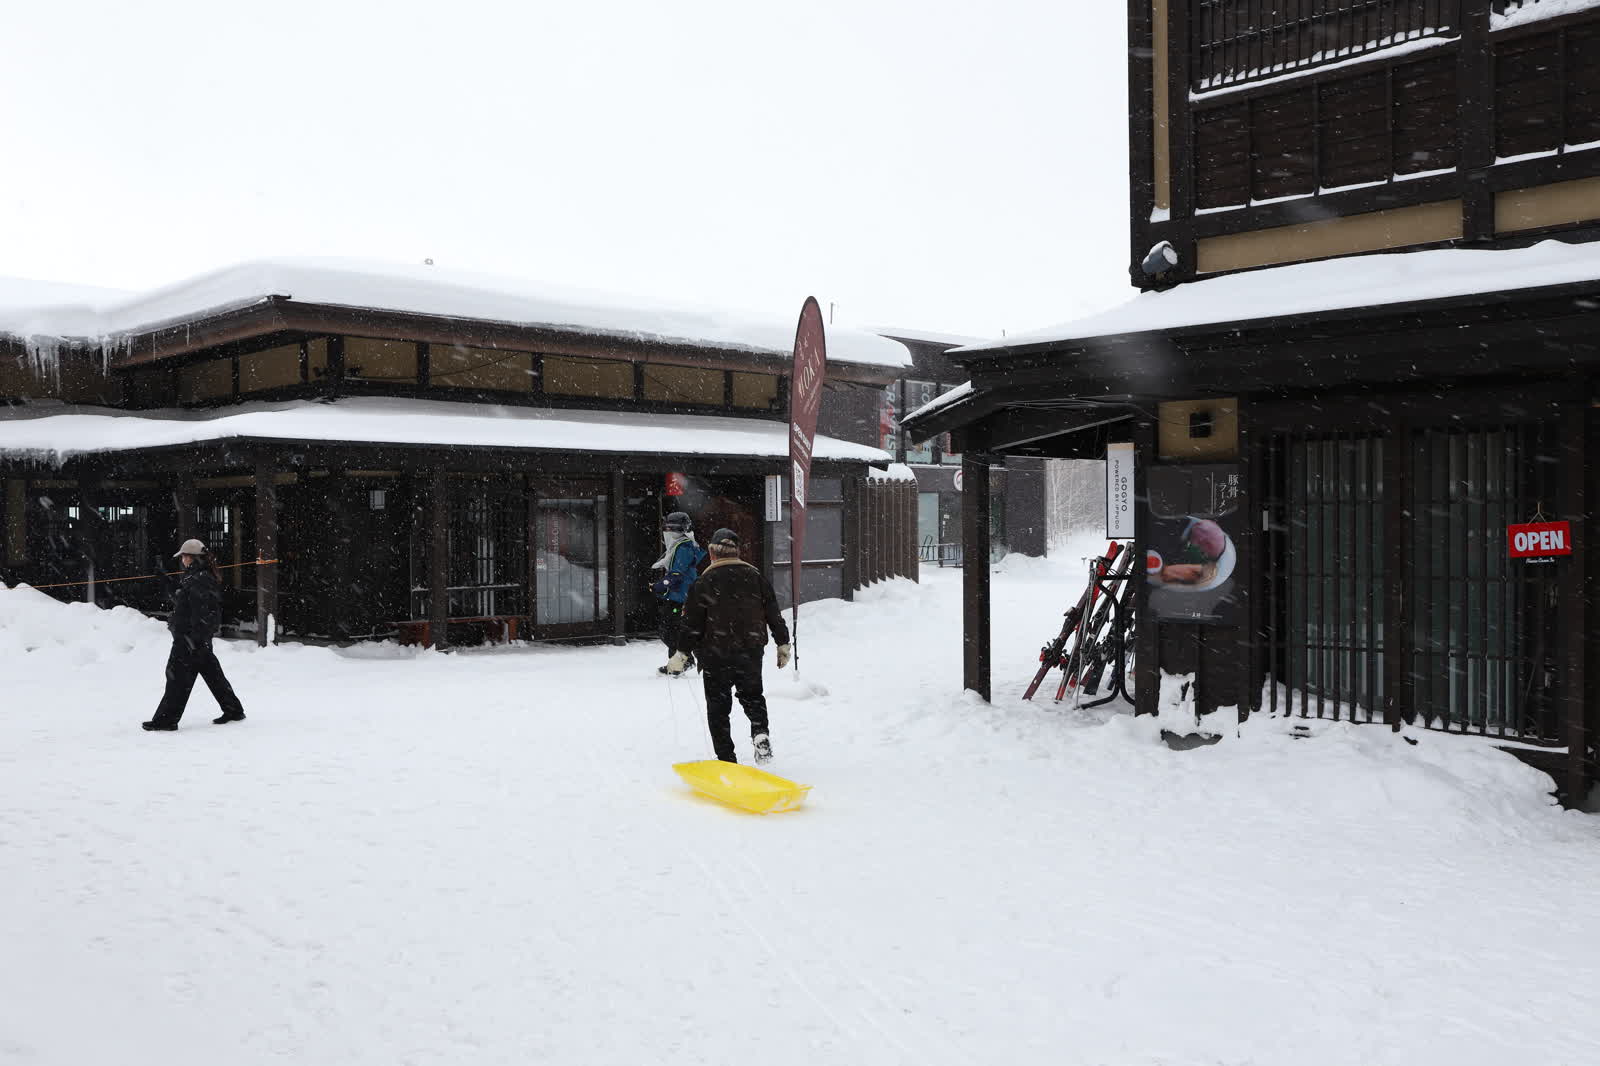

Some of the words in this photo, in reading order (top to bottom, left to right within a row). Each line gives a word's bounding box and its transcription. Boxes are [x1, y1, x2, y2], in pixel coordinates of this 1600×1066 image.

[1114, 493, 1120, 502] BY
[1228, 474, 1239, 498] 豚骨
[1218, 482, 1227, 516] ラーメン
[1514, 530, 1564, 552] OPEN
